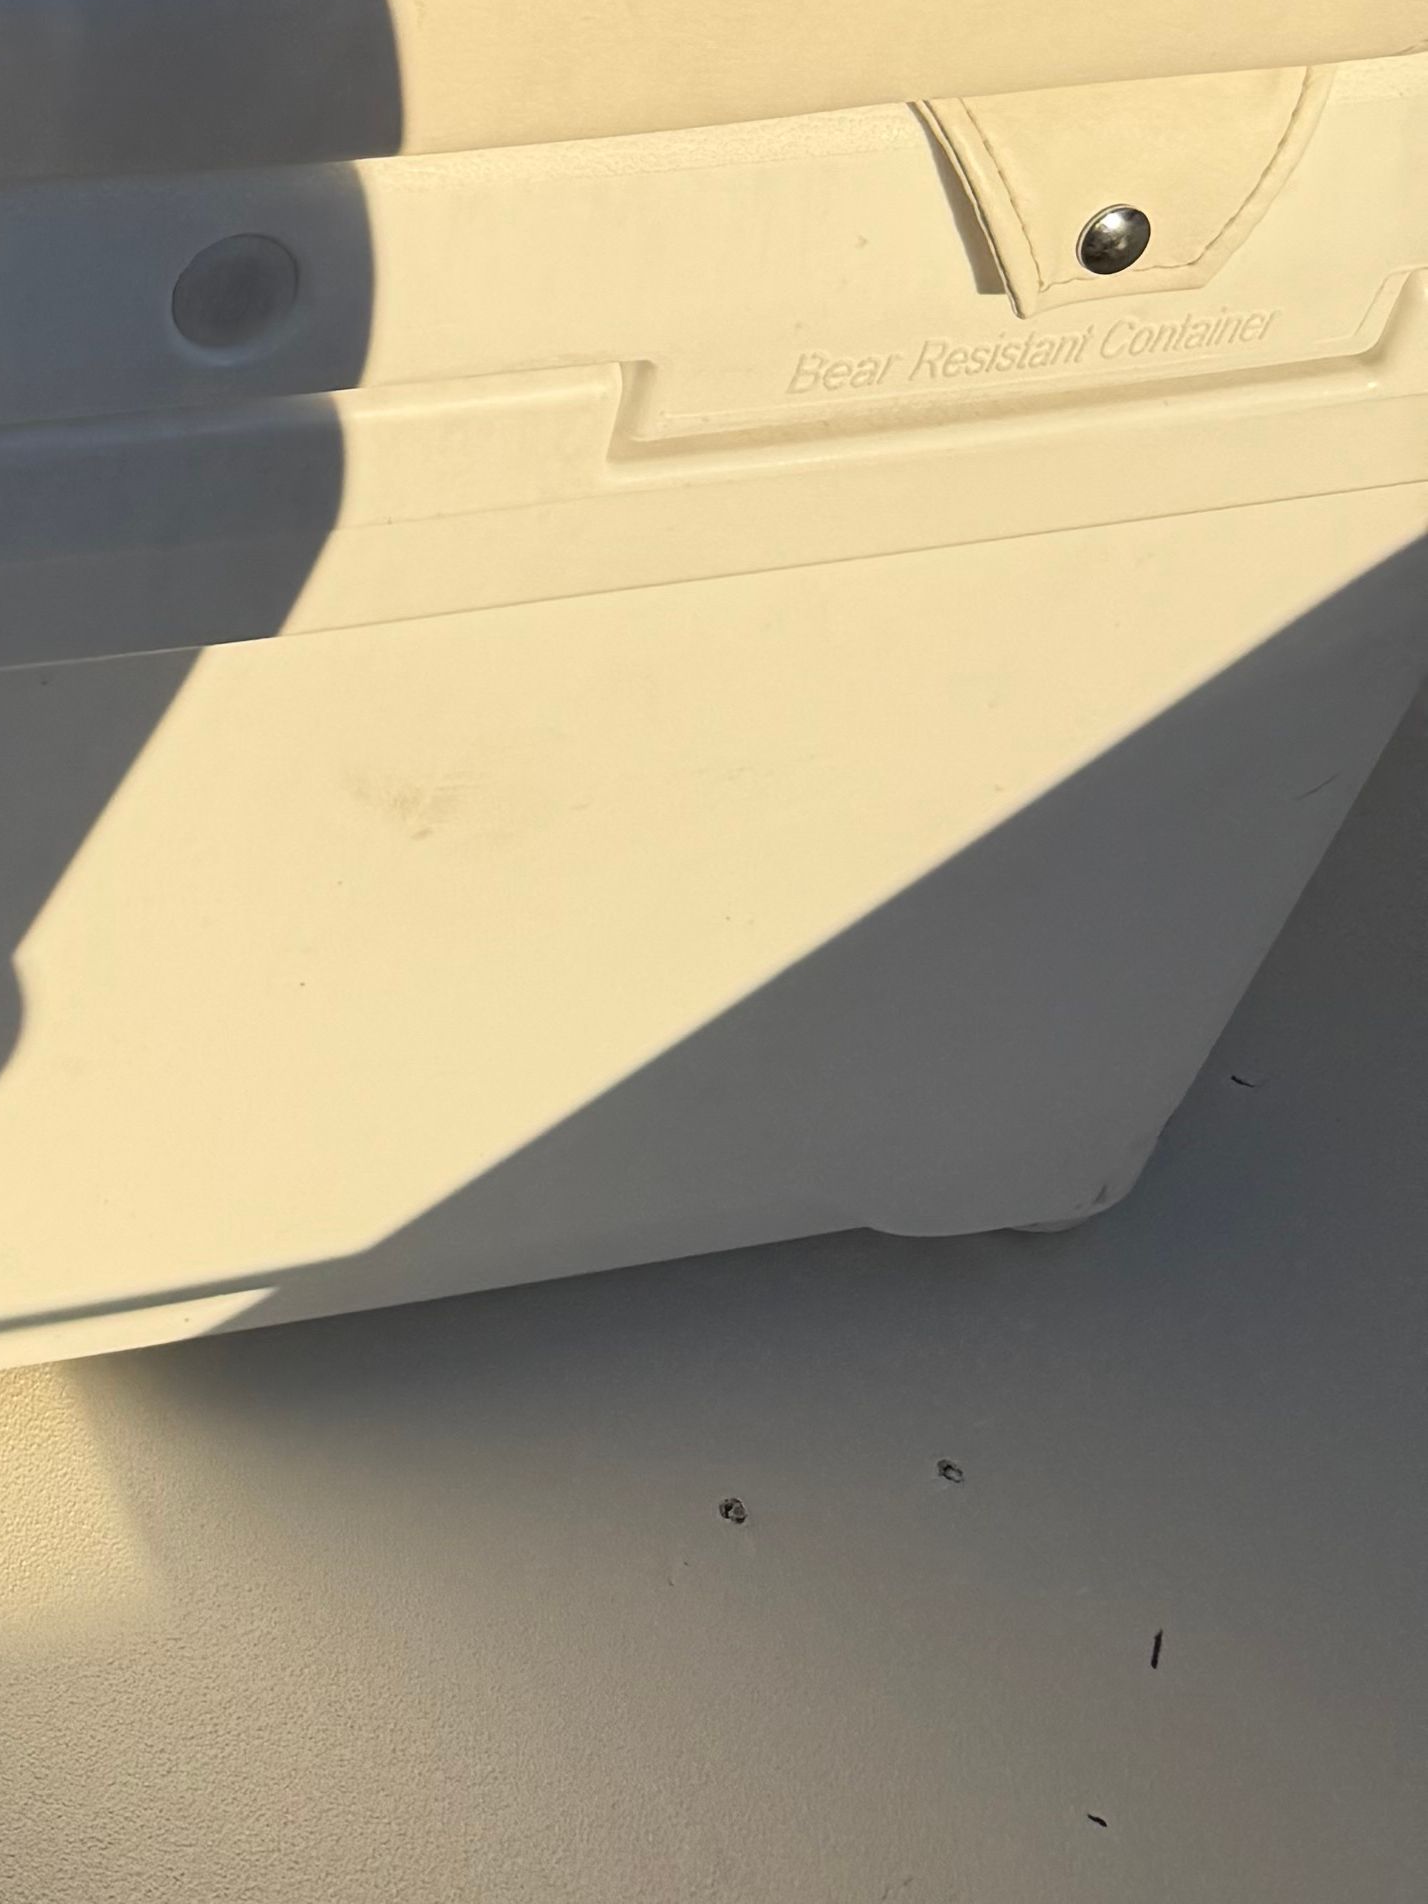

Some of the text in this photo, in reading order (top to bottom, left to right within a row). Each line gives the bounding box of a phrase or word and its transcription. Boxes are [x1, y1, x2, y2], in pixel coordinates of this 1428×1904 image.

[785, 305, 1284, 395] Bear Resistant Container
